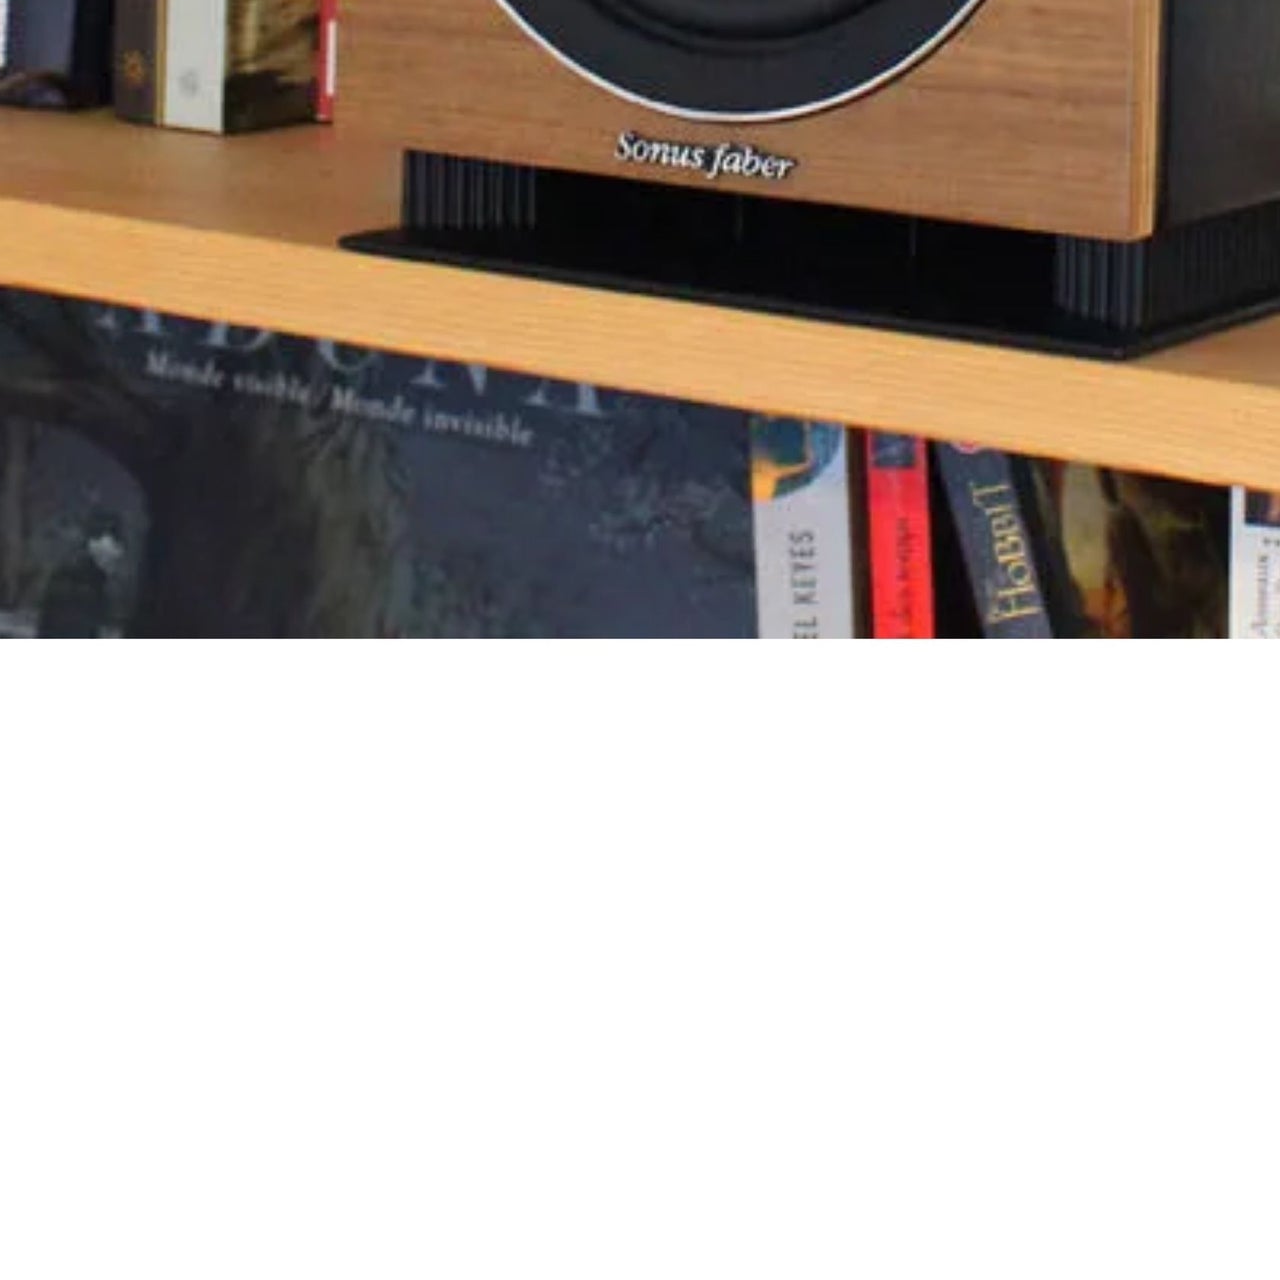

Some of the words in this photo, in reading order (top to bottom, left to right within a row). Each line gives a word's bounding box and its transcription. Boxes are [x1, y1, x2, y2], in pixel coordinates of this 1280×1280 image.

[614, 130, 705, 168] Sonus
[706, 142, 795, 180] faber
[145, 348, 224, 390] Monde
[231, 367, 310, 404] visible
[329, 388, 415, 424] Monde
[423, 408, 534, 446] invisible
